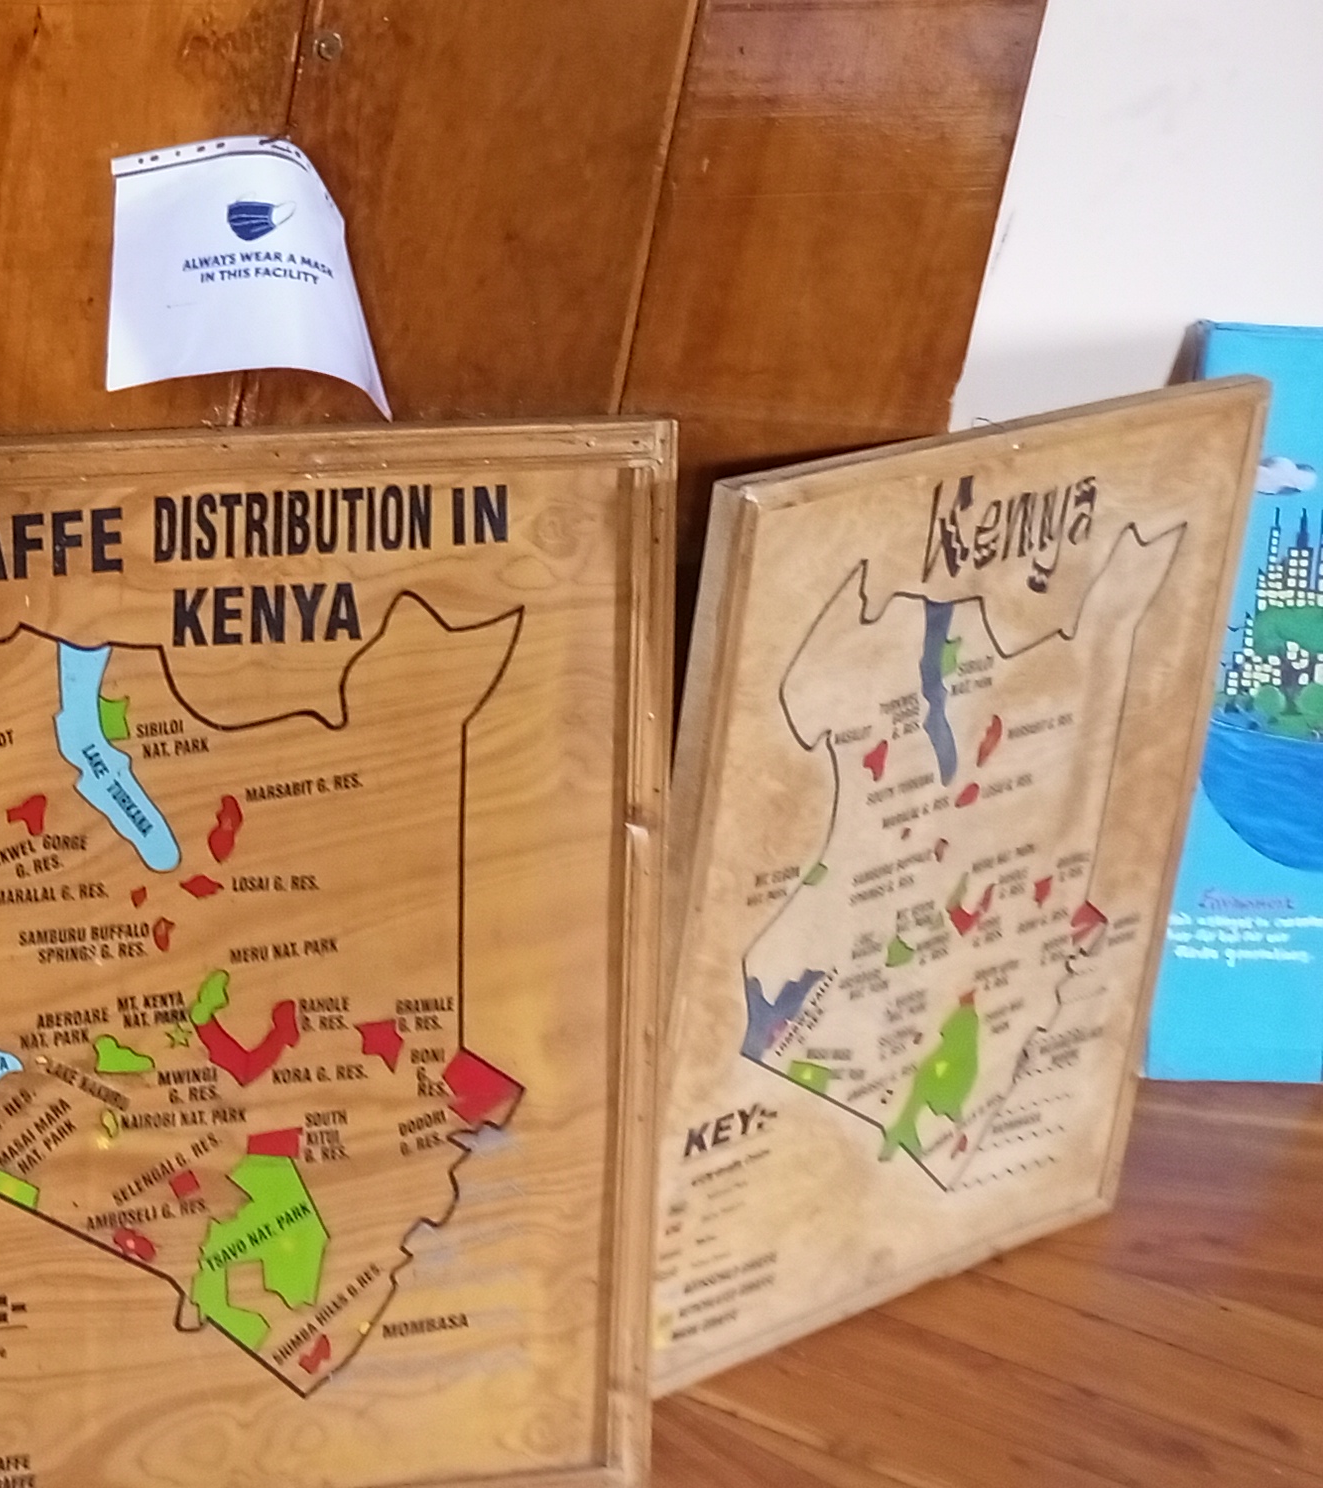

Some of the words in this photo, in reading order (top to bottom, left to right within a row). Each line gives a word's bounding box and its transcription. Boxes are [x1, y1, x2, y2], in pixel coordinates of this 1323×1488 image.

[182, 252, 237, 272] ALWAYS
[240, 251, 283, 265] WEAR
[287, 253, 296, 265] A
[300, 255, 334, 279] MASK
[200, 271, 215, 284] IN
[219, 268, 251, 282] THIS
[254, 266, 320, 285] FACILITY
[153, 484, 434, 565] DISTRIBUTION
[451, 484, 510, 548] IN
[921, 474, 1096, 594] Kenya
[171, 582, 363, 648] KENYA
[135, 719, 184, 739] SIBILOI
[141, 743, 171, 759] NAT.
[174, 738, 209, 756] PARK
[244, 780, 313, 803] MARSABIT
[42, 834, 88, 852] GORGE
[231, 876, 270, 893] LOSAI
[18, 926, 87, 947] SAMBURU
[91, 922, 151, 945] BUFFALO
[229, 943, 269, 964] MERU
[303, 938, 339, 958] PARK
[271, 1068, 312, 1085] KORA
[121, 1112, 176, 1130] NAIROBI
[206, 1239, 246, 1273] TSAVO
[278, 1200, 312, 1231] PARK
[382, 1312, 470, 1339] MOMBASA
